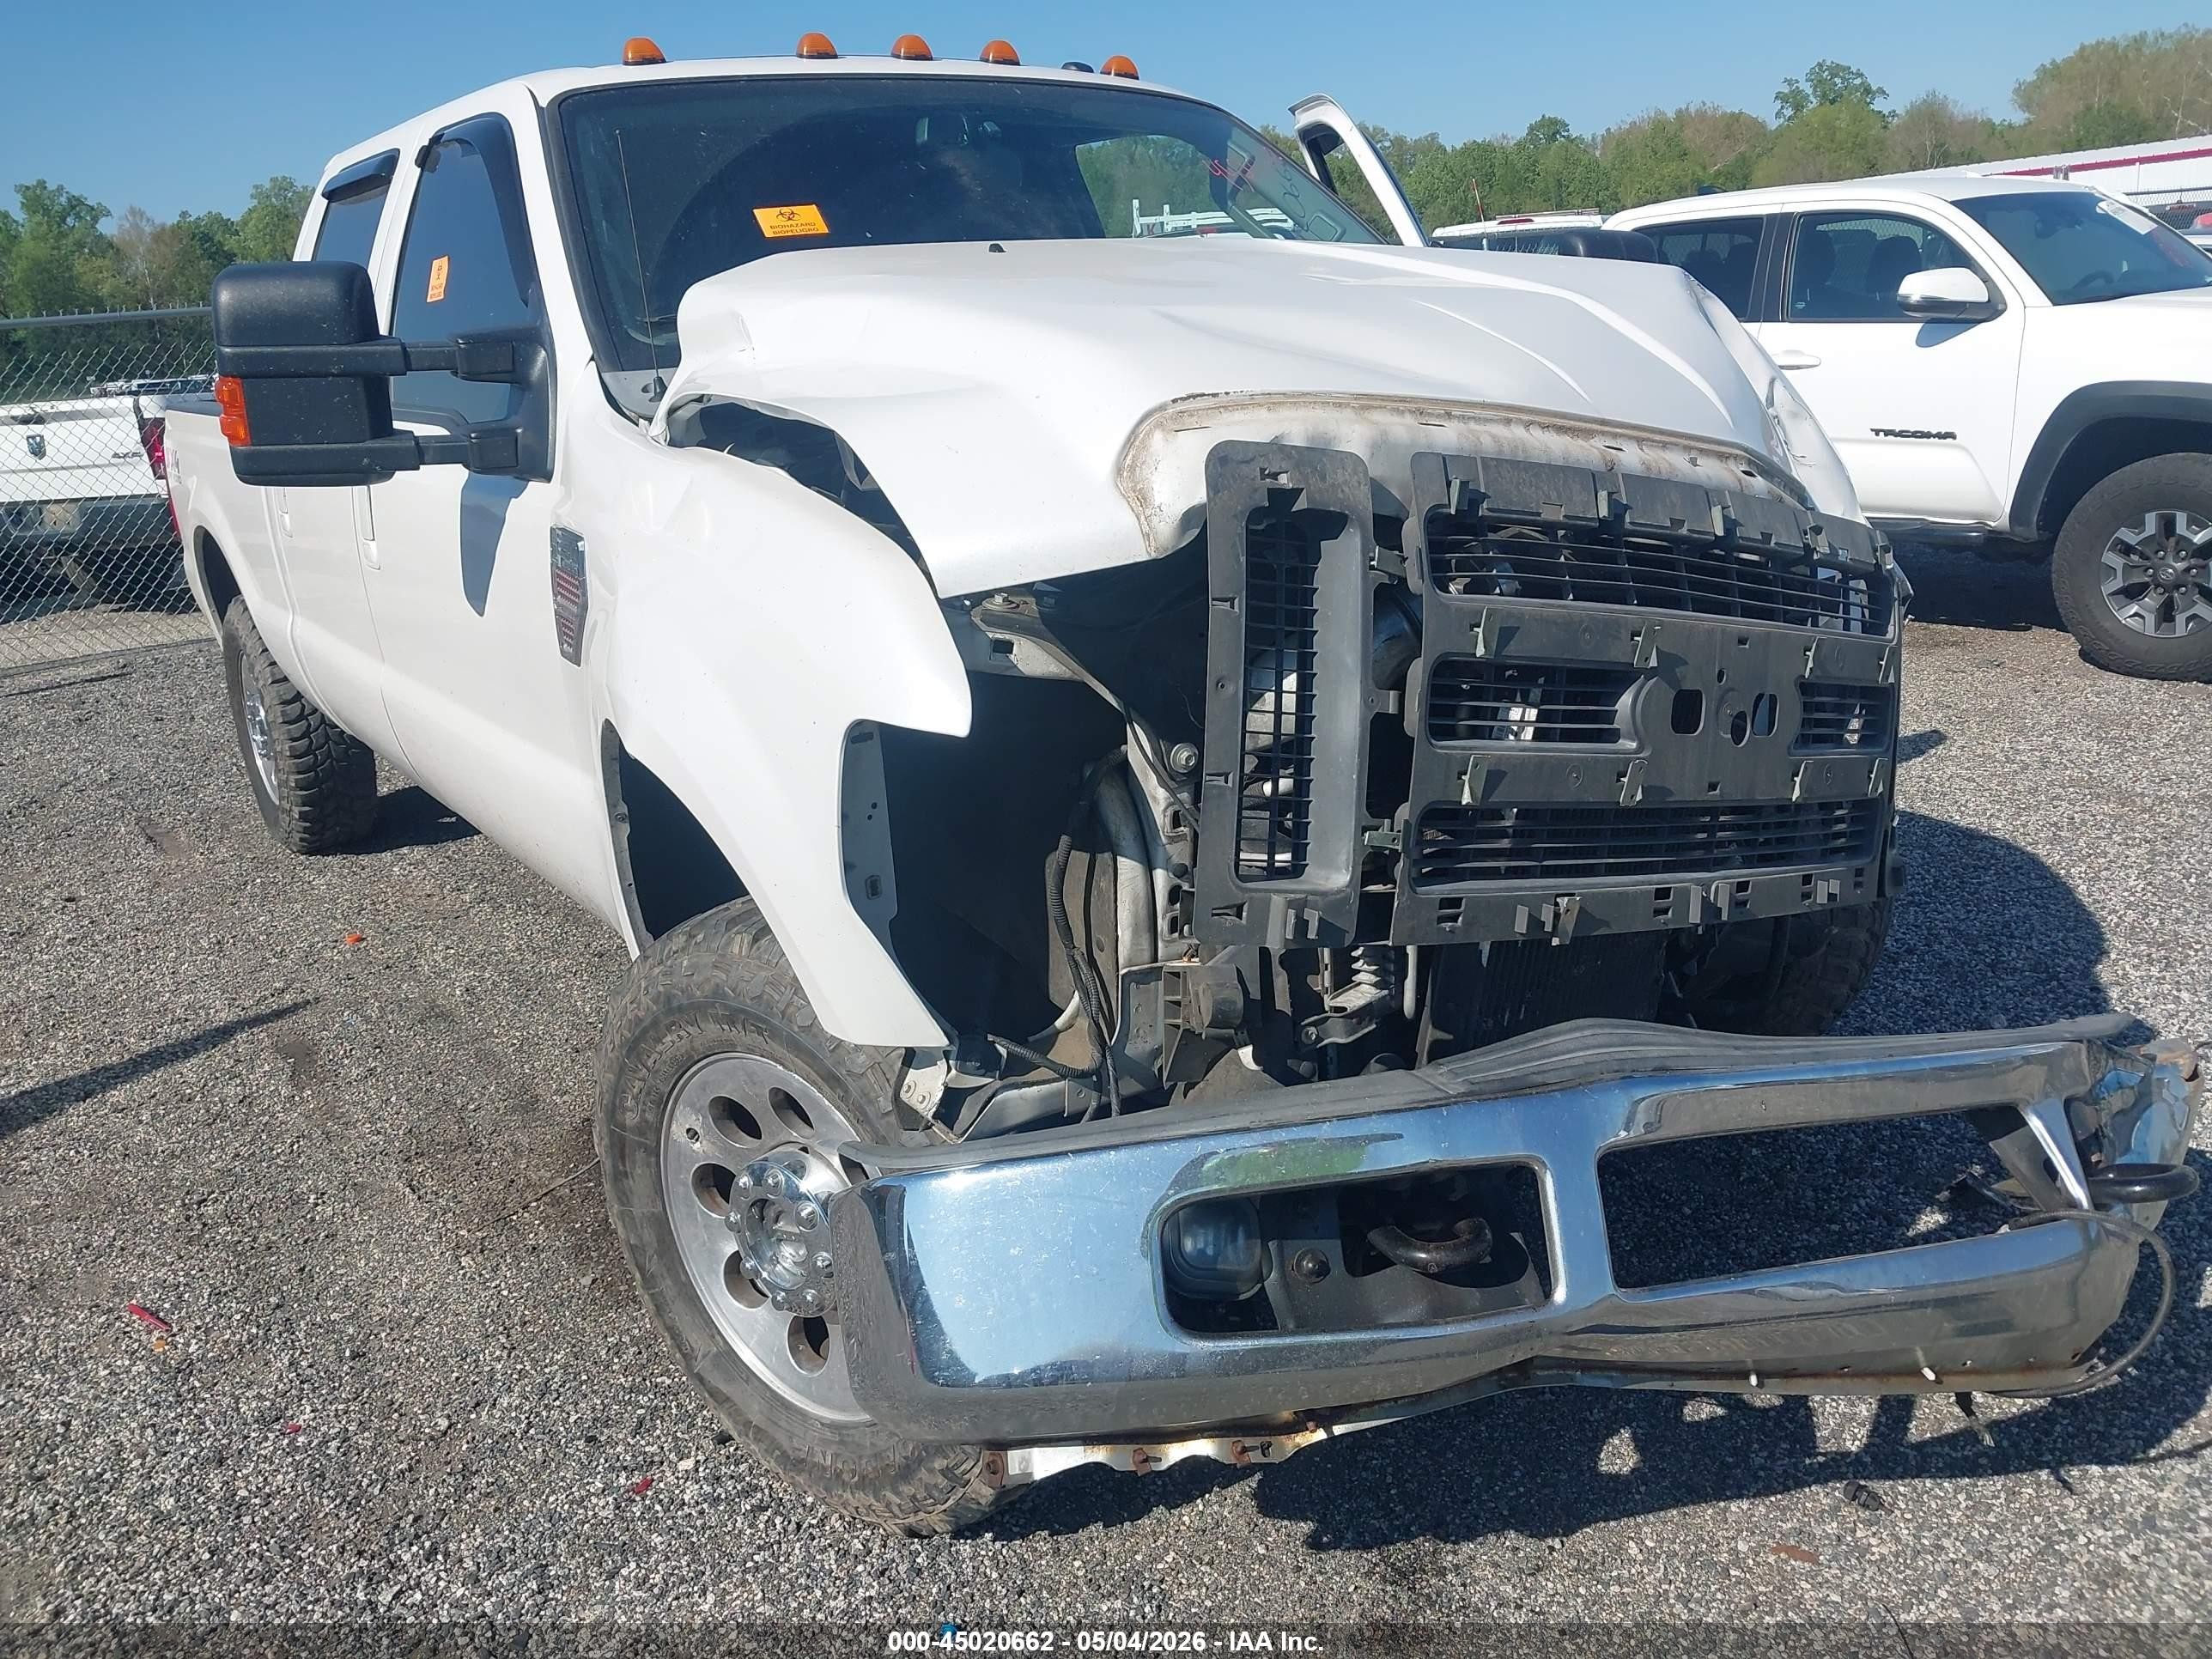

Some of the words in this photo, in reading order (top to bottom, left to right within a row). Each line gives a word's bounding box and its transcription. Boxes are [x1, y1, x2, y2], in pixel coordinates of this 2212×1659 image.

[769, 222, 817, 230] BIOHAZARD
[772, 227, 819, 235] BIOPELIGRO
[1869, 428, 1957, 441] TACOMA
